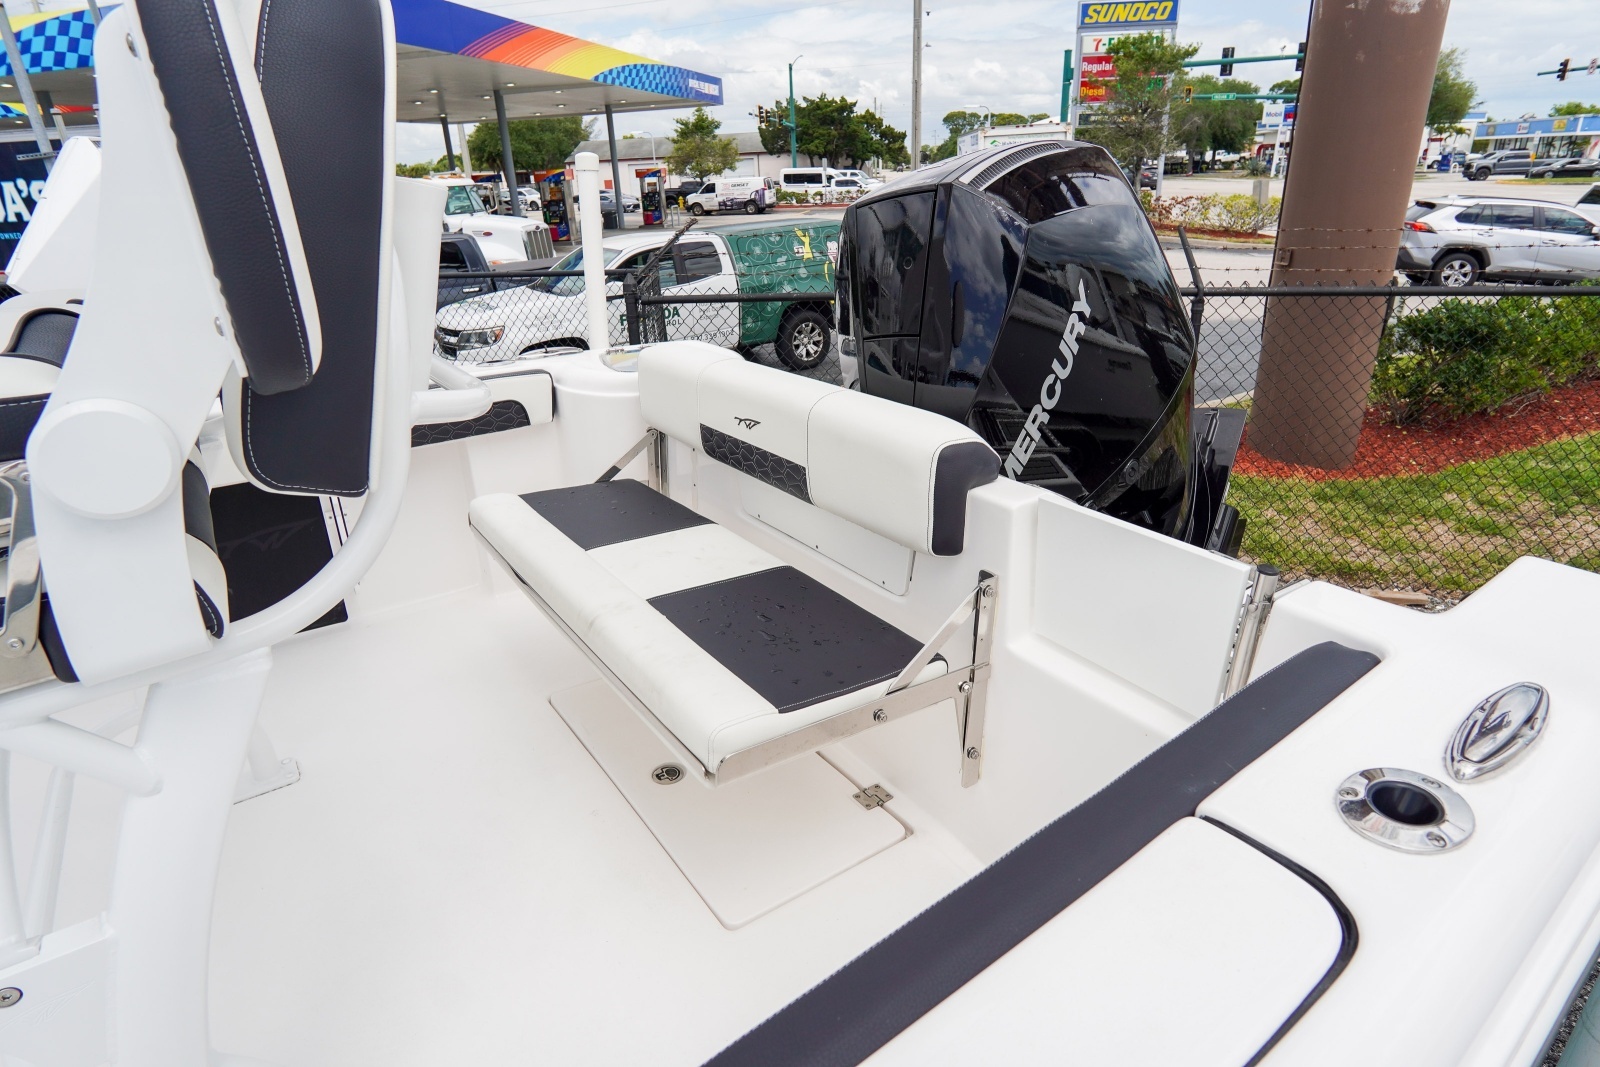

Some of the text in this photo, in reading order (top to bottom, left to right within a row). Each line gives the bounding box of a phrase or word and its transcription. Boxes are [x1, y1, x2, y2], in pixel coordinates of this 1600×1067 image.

[1083, 1, 1174, 24] SUNOCO
[1082, 61, 1113, 73] Regular
[1080, 86, 1106, 97] Diesel
[1003, 278, 1092, 481] MERCURY
